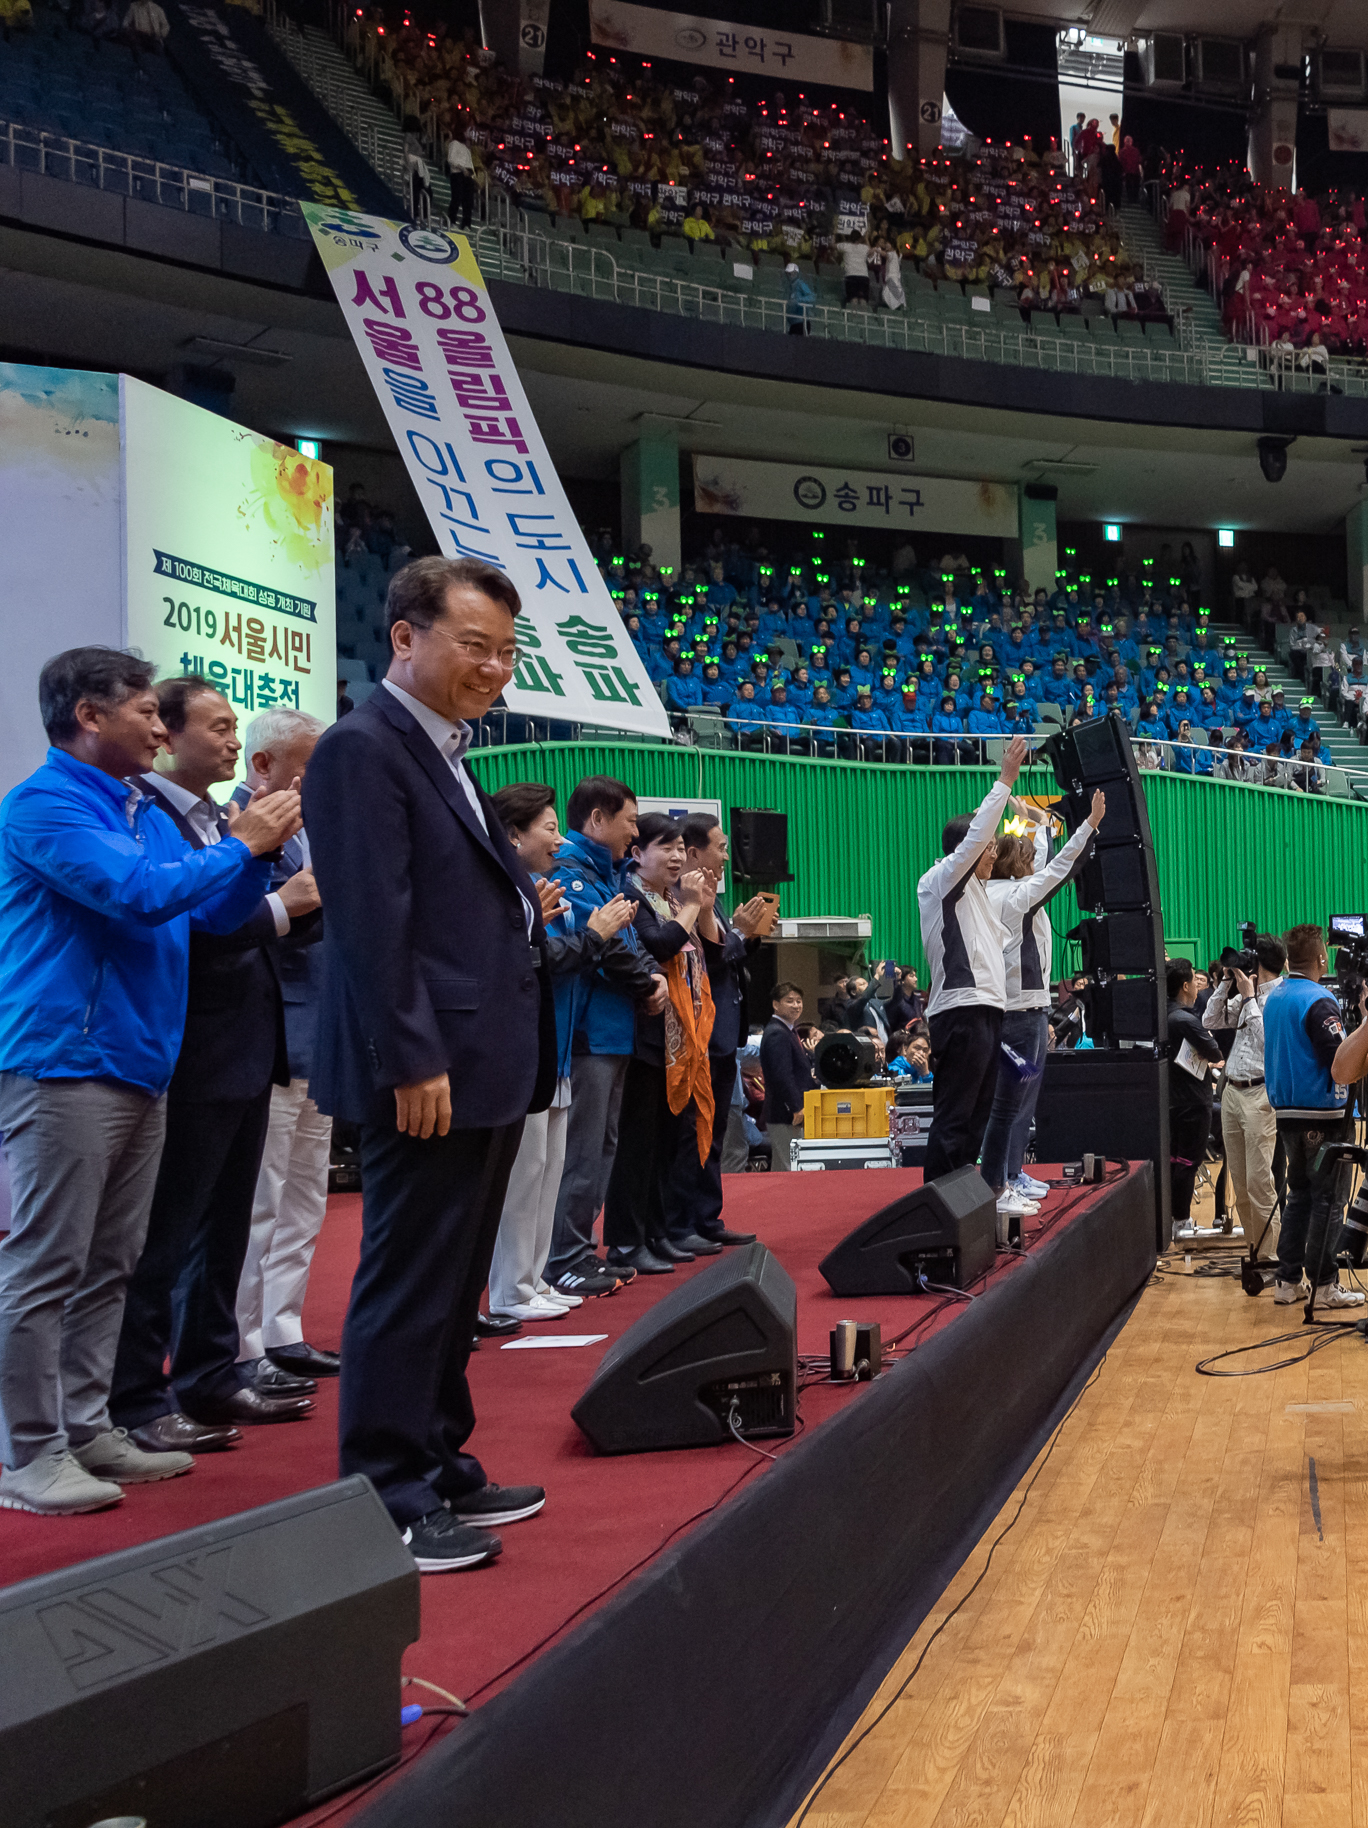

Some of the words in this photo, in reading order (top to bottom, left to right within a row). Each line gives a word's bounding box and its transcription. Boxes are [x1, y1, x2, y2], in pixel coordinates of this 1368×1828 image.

[525, 27, 544, 43] 21
[715, 30, 796, 66] 관악구
[922, 103, 939, 121] 21
[505, 134, 535, 149] 관악구
[547, 143, 574, 158] 관악구
[723, 193, 751, 208] 관악구
[840, 200, 870, 215] 관악구
[742, 220, 773, 234] 관악구
[837, 218, 866, 232] 관악구
[333, 235, 380, 253] 송파구
[945, 248, 975, 263] 관악구
[351, 269, 442, 421] 서울을
[414, 281, 546, 495] 88올림픽의
[506, 512, 590, 594] 도시
[555, 614, 644, 707] 송파
[652, 486, 670, 511] 3
[833, 481, 925, 516] 송파구
[1033, 522, 1048, 545] 3
[161, 556, 172, 573] 제
[174, 562, 202, 584] 100회
[203, 571, 257, 602] 전국체육대회
[258, 588, 276, 608] 성공
[277, 593, 294, 613] 개최
[295, 600, 312, 618] 기원
[162, 596, 218, 639] 2019
[220, 611, 312, 675] 서울시민
